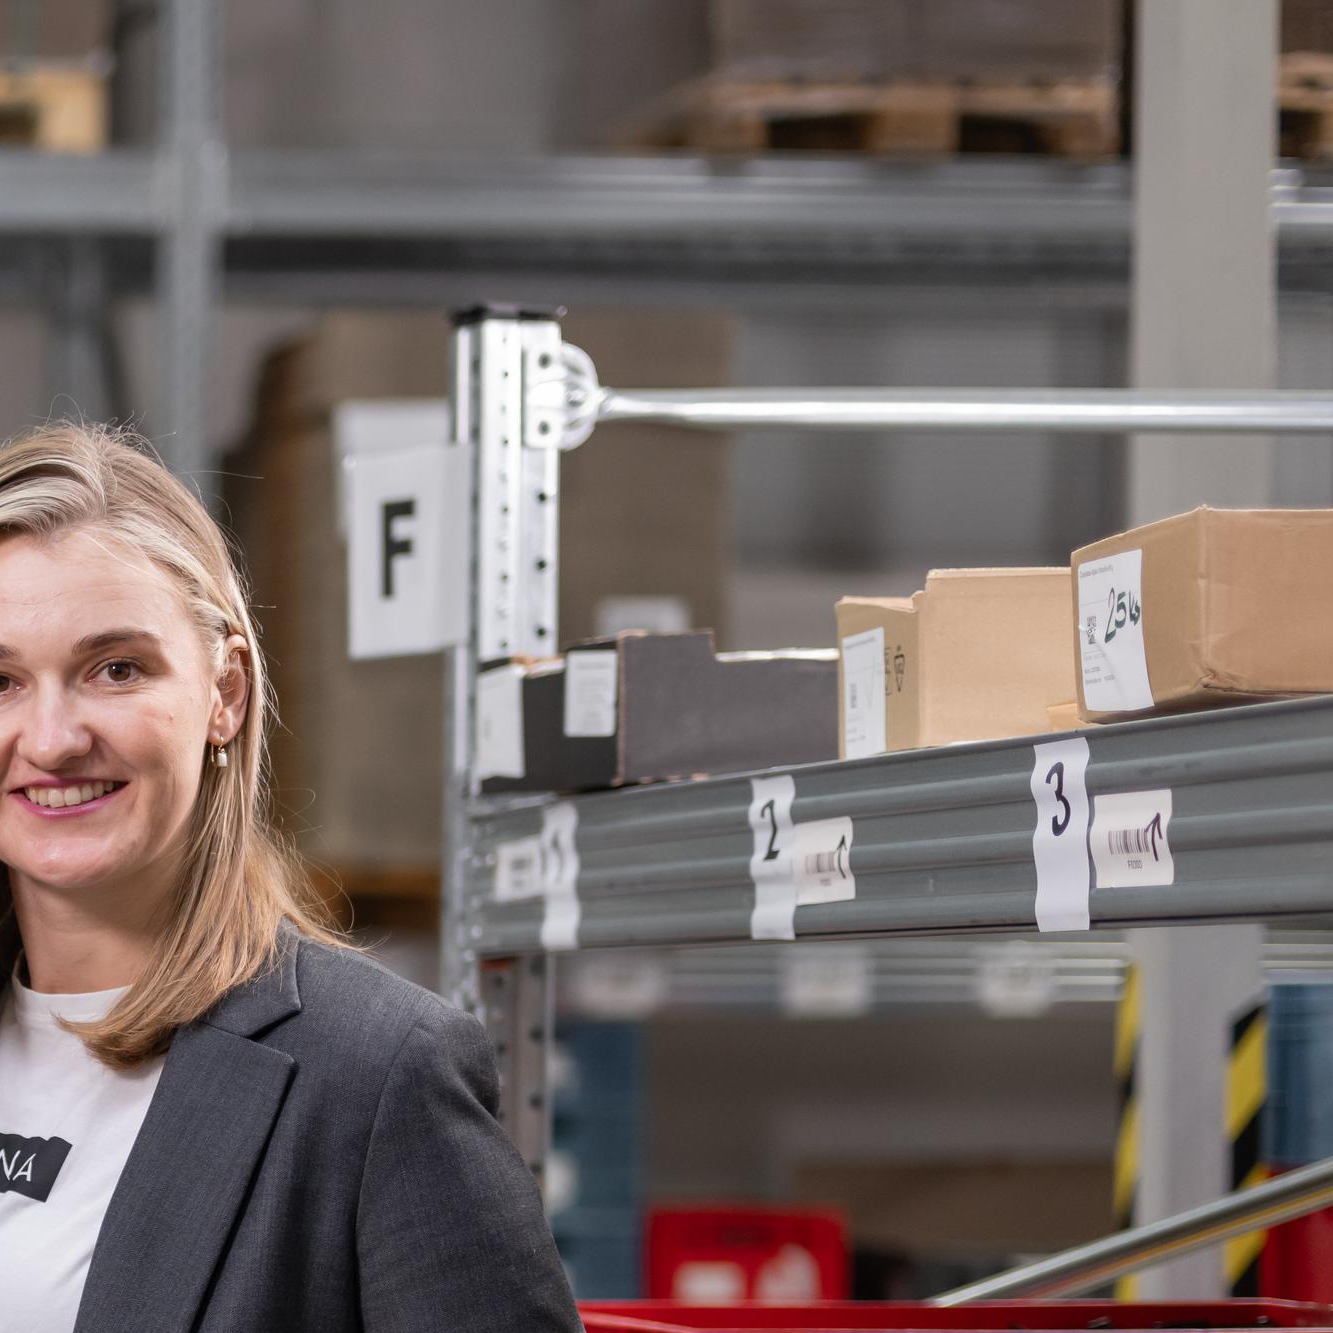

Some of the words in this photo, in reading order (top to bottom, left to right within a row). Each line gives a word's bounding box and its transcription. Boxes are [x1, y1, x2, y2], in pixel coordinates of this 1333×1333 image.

[381, 499, 415, 598] F
[760, 799, 780, 861] 2
[1045, 761, 1071, 837] 3
